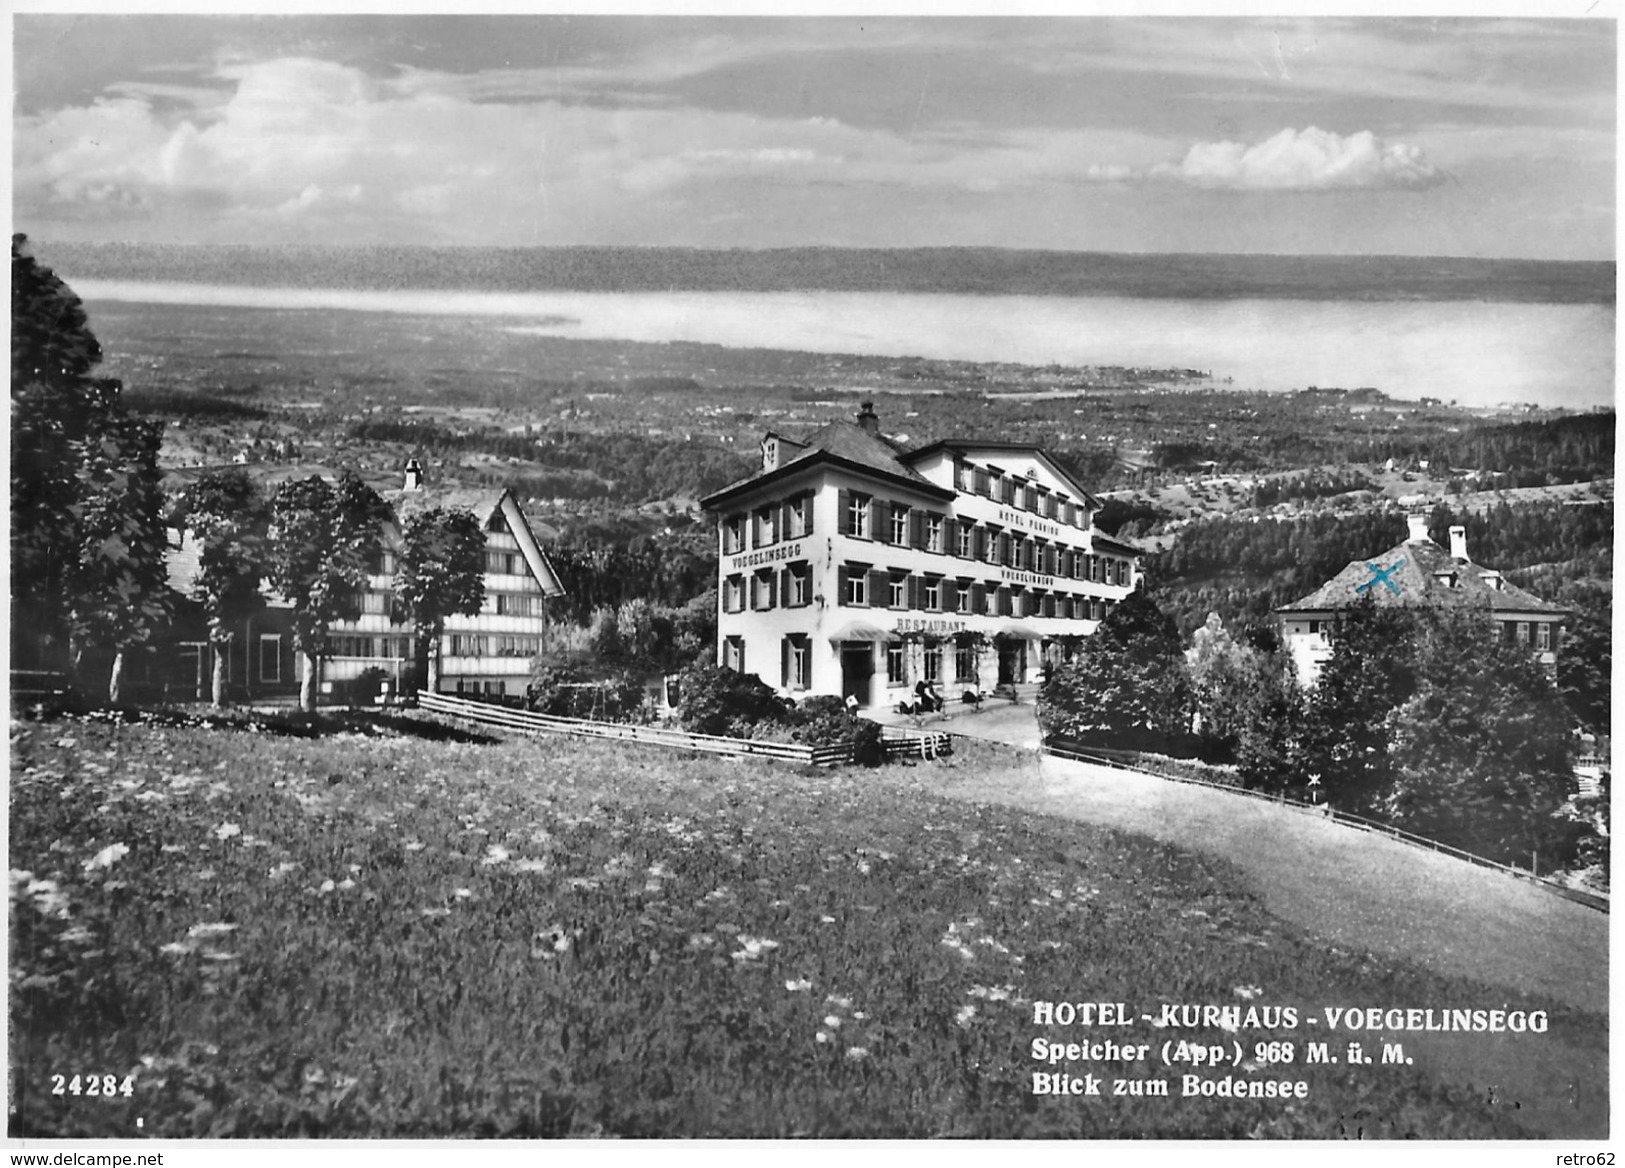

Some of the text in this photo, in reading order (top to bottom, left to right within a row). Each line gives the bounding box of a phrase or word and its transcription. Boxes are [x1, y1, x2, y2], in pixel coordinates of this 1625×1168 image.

[1000, 510, 1023, 526] HOTEL
[732, 543, 801, 568] VOEGELINSEGG
[897, 618, 966, 633] RESTAURANT
